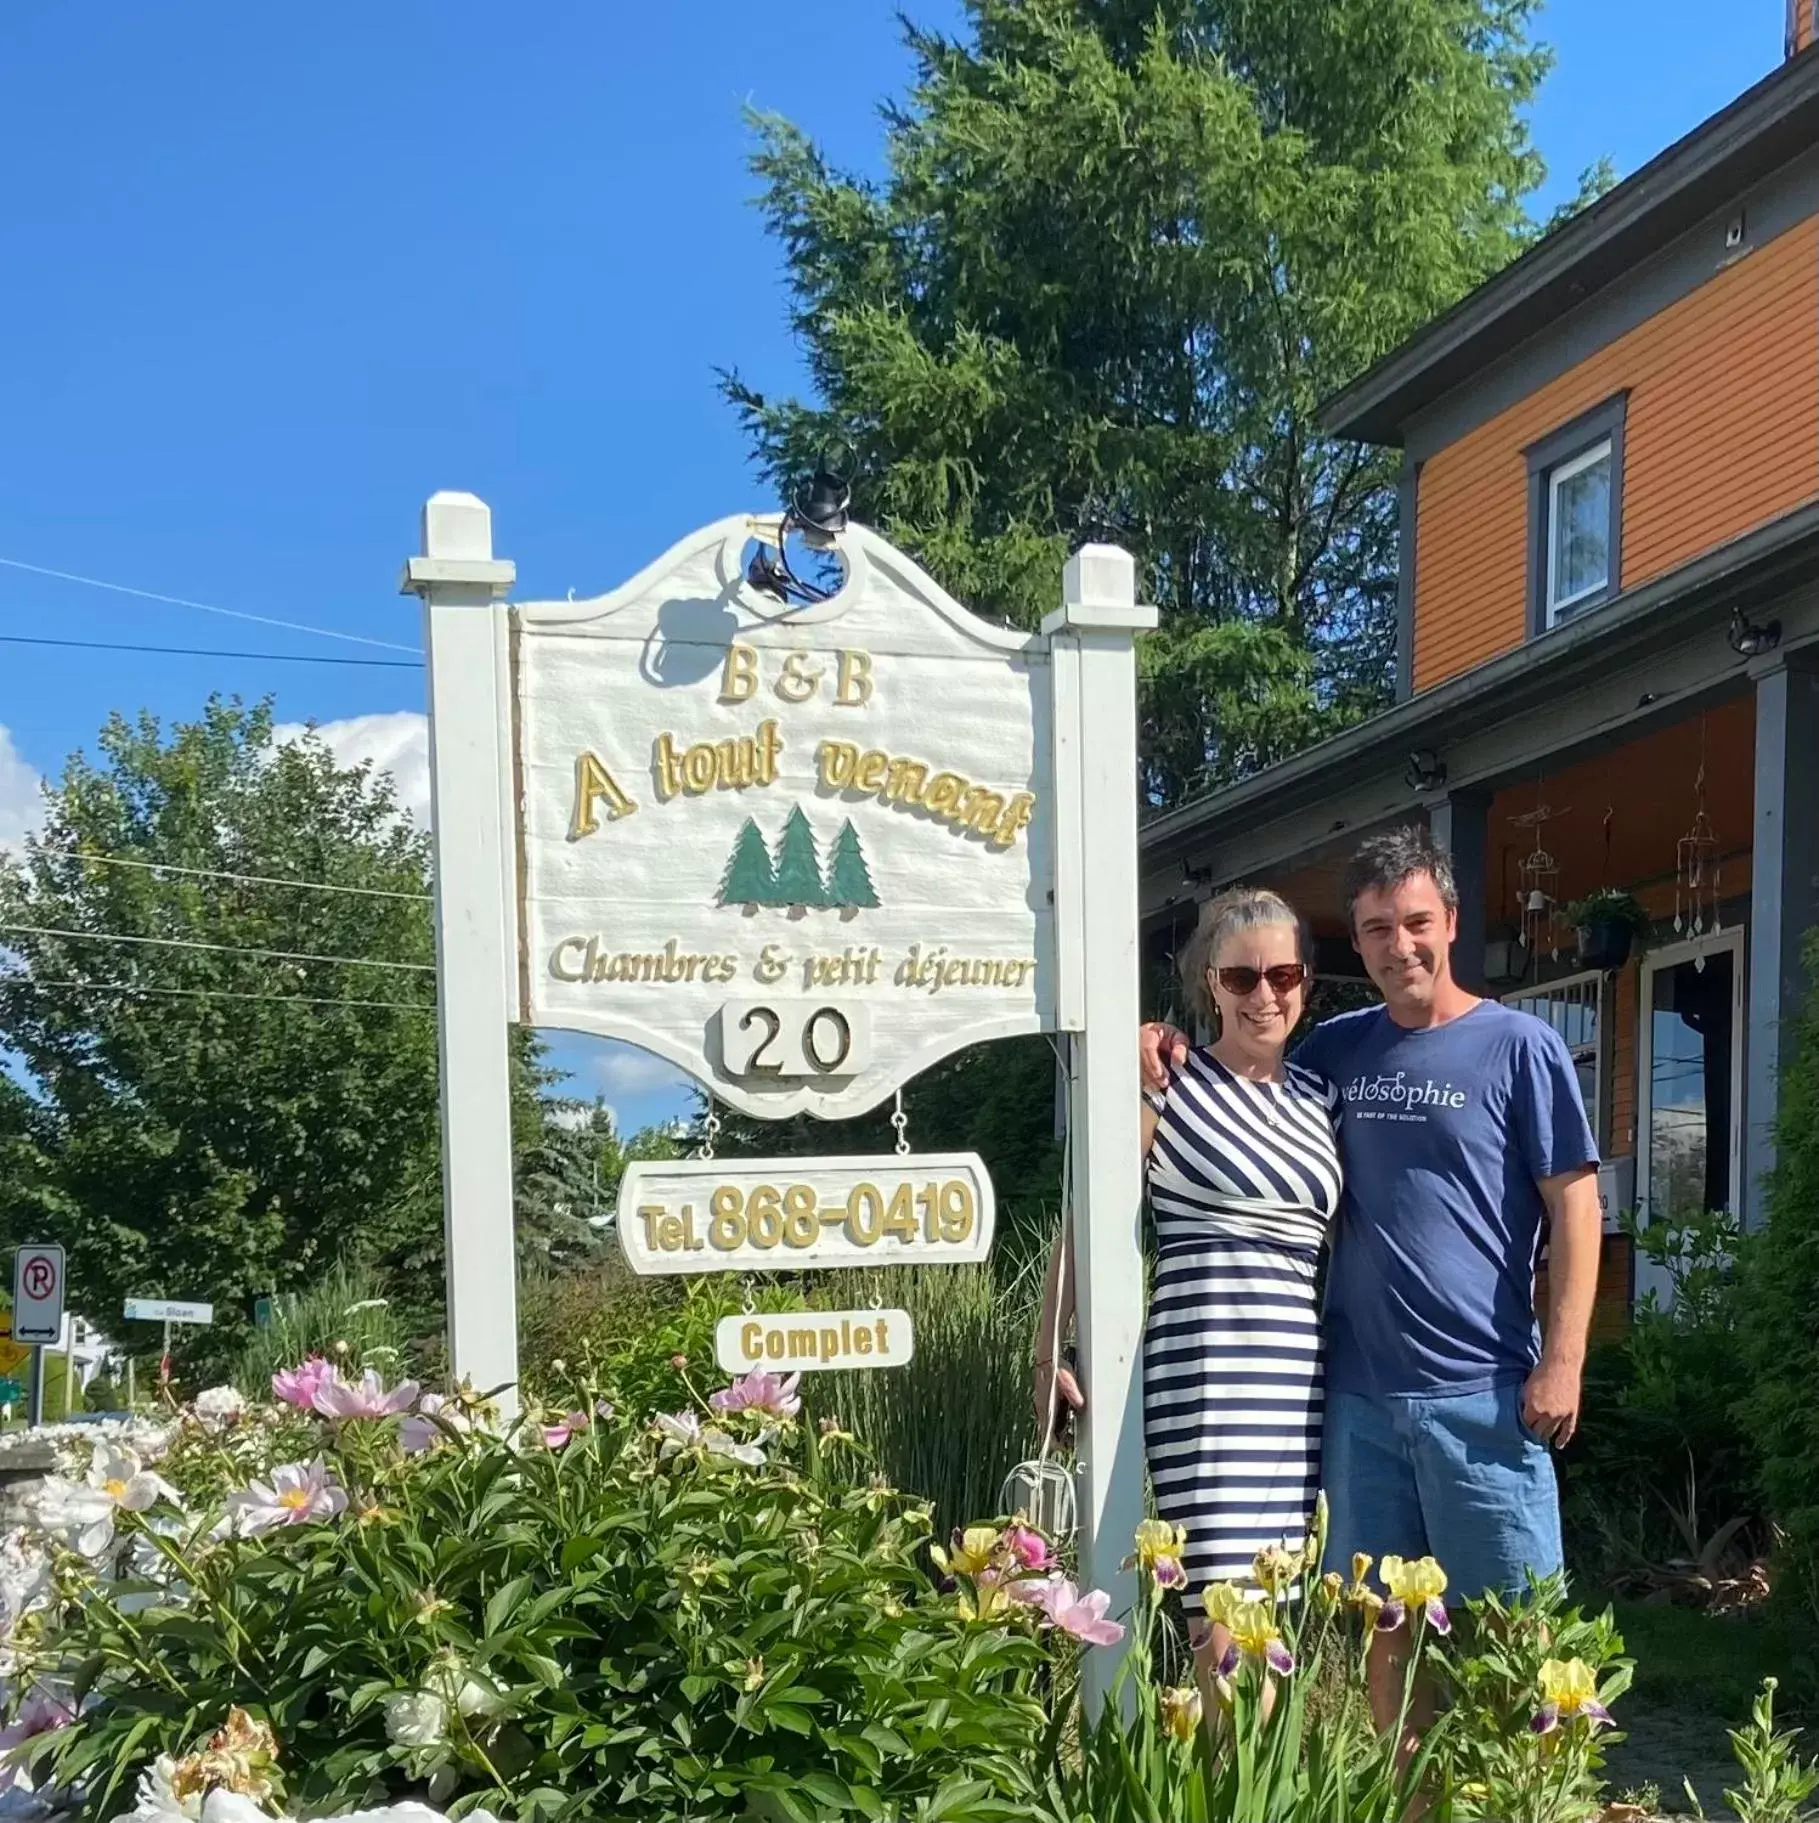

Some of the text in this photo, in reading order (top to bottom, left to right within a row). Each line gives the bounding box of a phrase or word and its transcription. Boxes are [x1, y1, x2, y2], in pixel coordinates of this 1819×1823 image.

[718, 643, 875, 707] B & B
[568, 718, 1036, 847] A tout venant
[548, 933, 1036, 995] Chambres & petit déjeuner
[738, 1005, 851, 1074] 20
[708, 1179, 974, 1250] 868-0419
[739, 1318, 890, 1364] Complet
